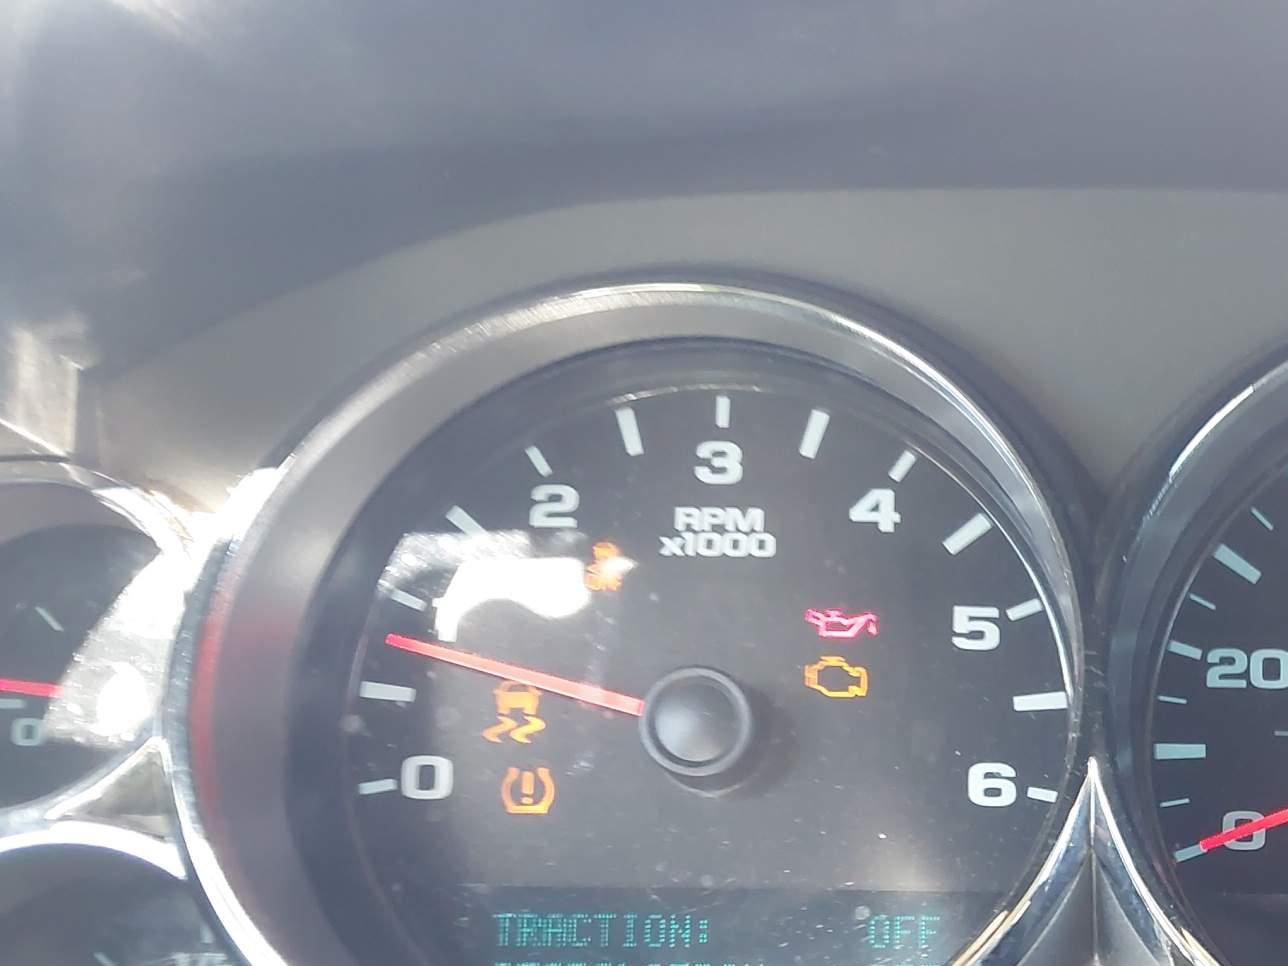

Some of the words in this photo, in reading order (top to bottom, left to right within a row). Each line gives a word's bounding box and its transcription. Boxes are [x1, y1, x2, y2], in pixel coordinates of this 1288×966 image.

[694, 439, 744, 485] 3
[529, 484, 580, 529] 2
[674, 506, 766, 533] RPM
[849, 488, 901, 533] 4
[659, 533, 777, 559] x1000
[951, 606, 1001, 651] 5
[400, 755, 453, 800] 0
[967, 762, 1018, 807] 6
[1222, 810, 1267, 851] 0
[492, 912, 711, 948] TRACTION:
[868, 915, 941, 950] OFF
